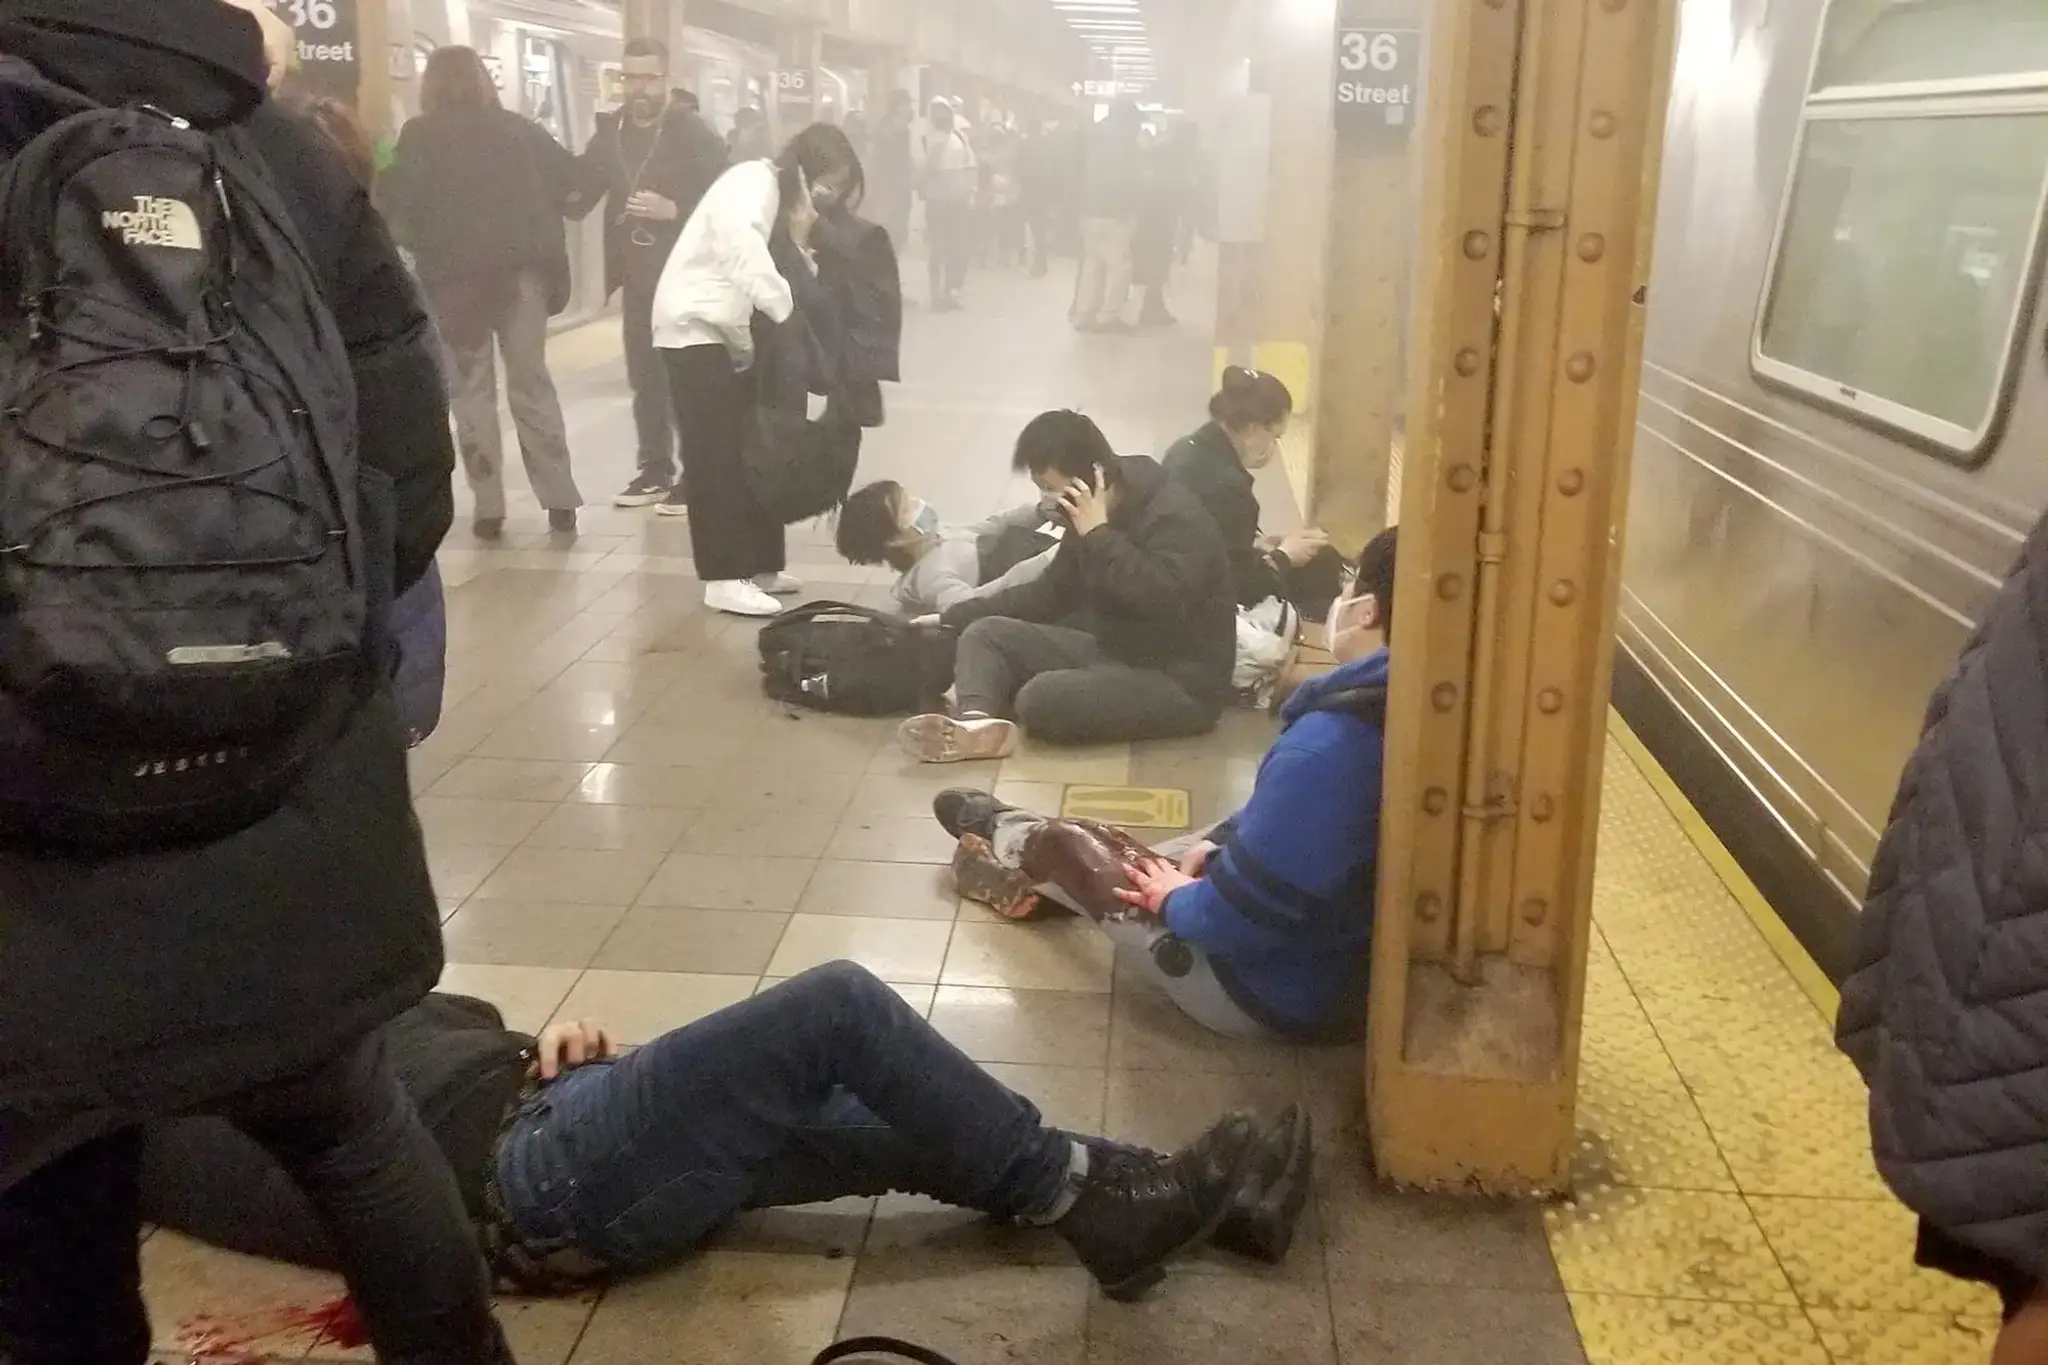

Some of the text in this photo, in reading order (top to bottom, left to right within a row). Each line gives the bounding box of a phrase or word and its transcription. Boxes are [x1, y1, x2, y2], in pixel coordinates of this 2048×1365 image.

[296, 40, 354, 61] treet
[1340, 32, 1398, 71] 36
[779, 72, 804, 89] 36
[1338, 81, 1411, 104] Street
[132, 195, 172, 214] THE
[101, 210, 169, 230] NORTH
[122, 229, 174, 246] FACE
